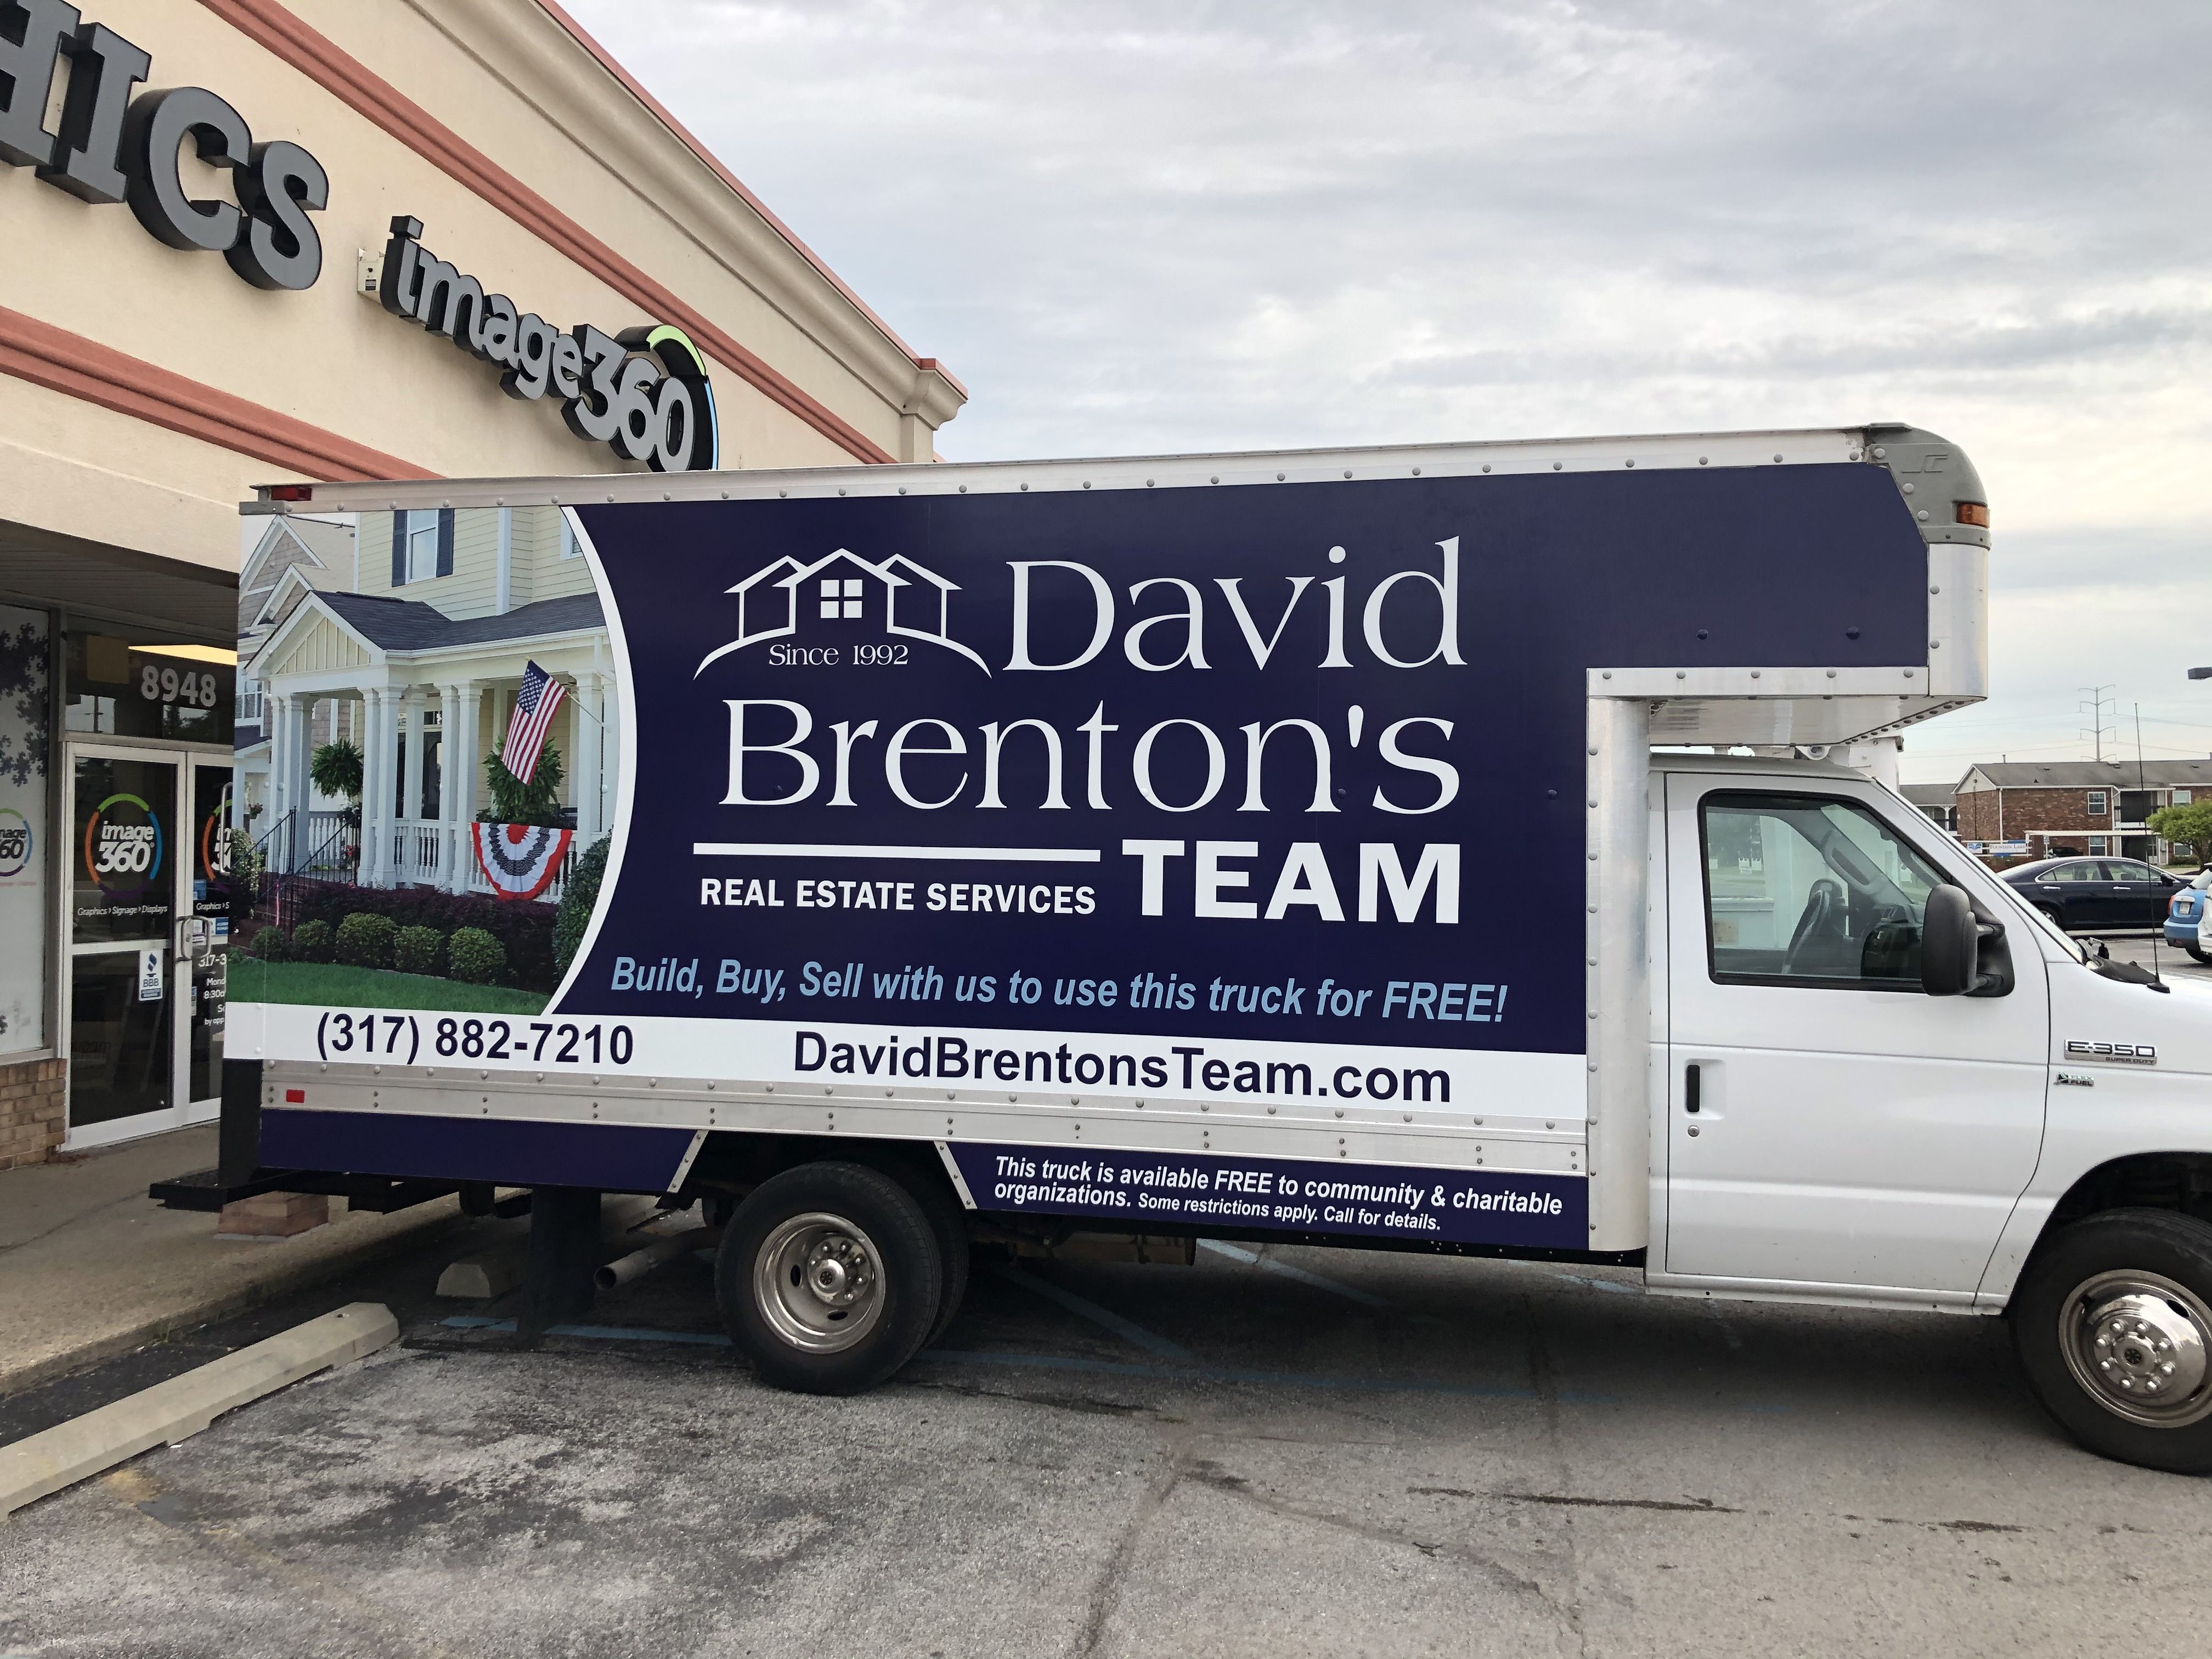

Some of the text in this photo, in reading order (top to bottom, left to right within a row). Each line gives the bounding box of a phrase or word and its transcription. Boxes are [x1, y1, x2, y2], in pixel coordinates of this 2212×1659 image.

[380, 216, 697, 472] image360
[1003, 535, 1468, 672] David
[769, 644, 909, 665] Since 1992
[141, 665, 216, 707] 8948
[719, 699, 1459, 815] Brenton's
[101, 820, 155, 840] image
[95, 842, 151, 872] 360
[1122, 839, 1460, 924] TEAM
[78, 905, 167, 917] Graphics Signage Displays
[196, 902, 221, 911] Graphics
[701, 878, 1096, 915] REAL ESTATE SERVICES
[143, 978, 159, 987] BBB
[611, 956, 1508, 1023] Build, Buy, Sell with us to use this truck for FREE!
[318, 1012, 634, 1065] (317) 882-7210
[794, 1031, 1450, 1103] DavidBrentonsTeam.com
[995, 1181, 1441, 1231] organizations. Some restrictions apply. Call for details.
[996, 1155, 1562, 1215] This truck is available FREE to community & charitable
